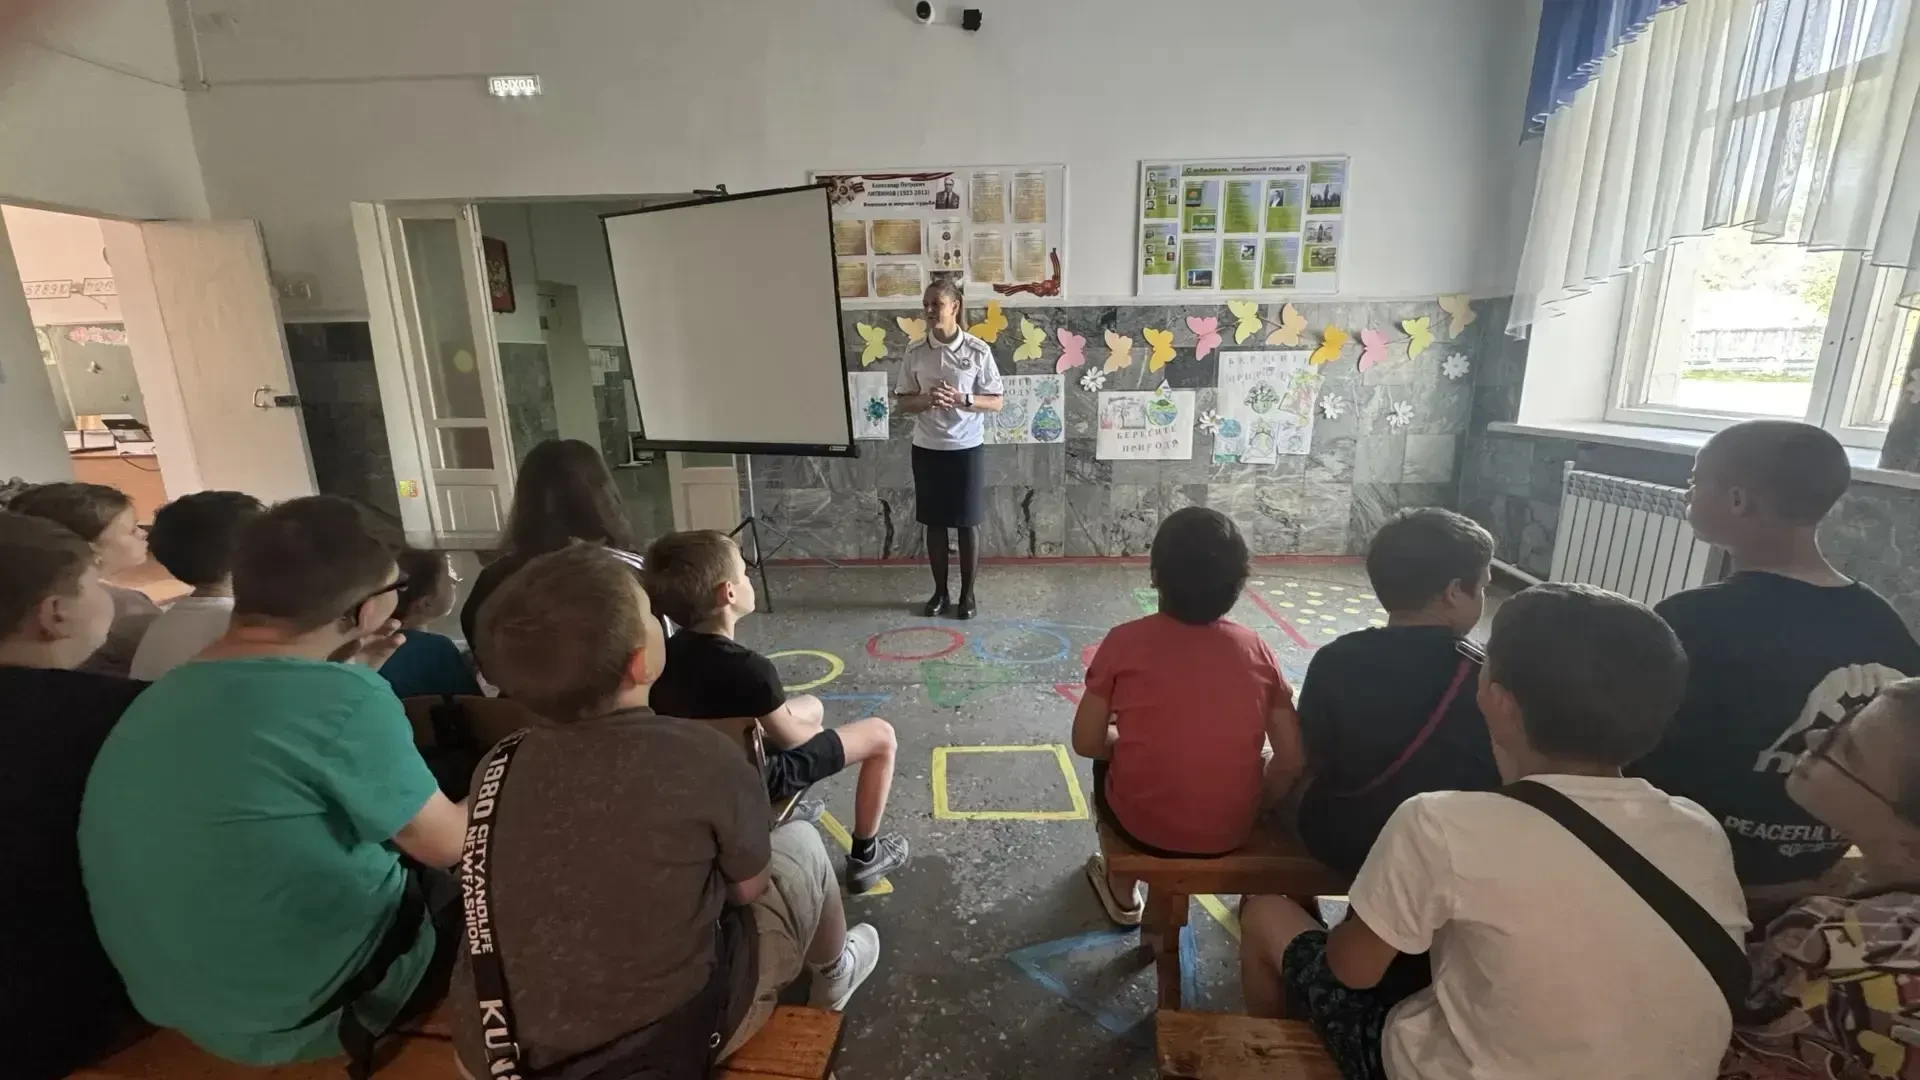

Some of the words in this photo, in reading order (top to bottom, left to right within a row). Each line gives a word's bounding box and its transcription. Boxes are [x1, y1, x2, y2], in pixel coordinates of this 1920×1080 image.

[493, 80, 536, 92] ВЫХОД
[1116, 426, 1177, 440] БЕРЕГИТЕ
[473, 753, 508, 819] 1980
[1723, 814, 1825, 841] PEACEFUL
